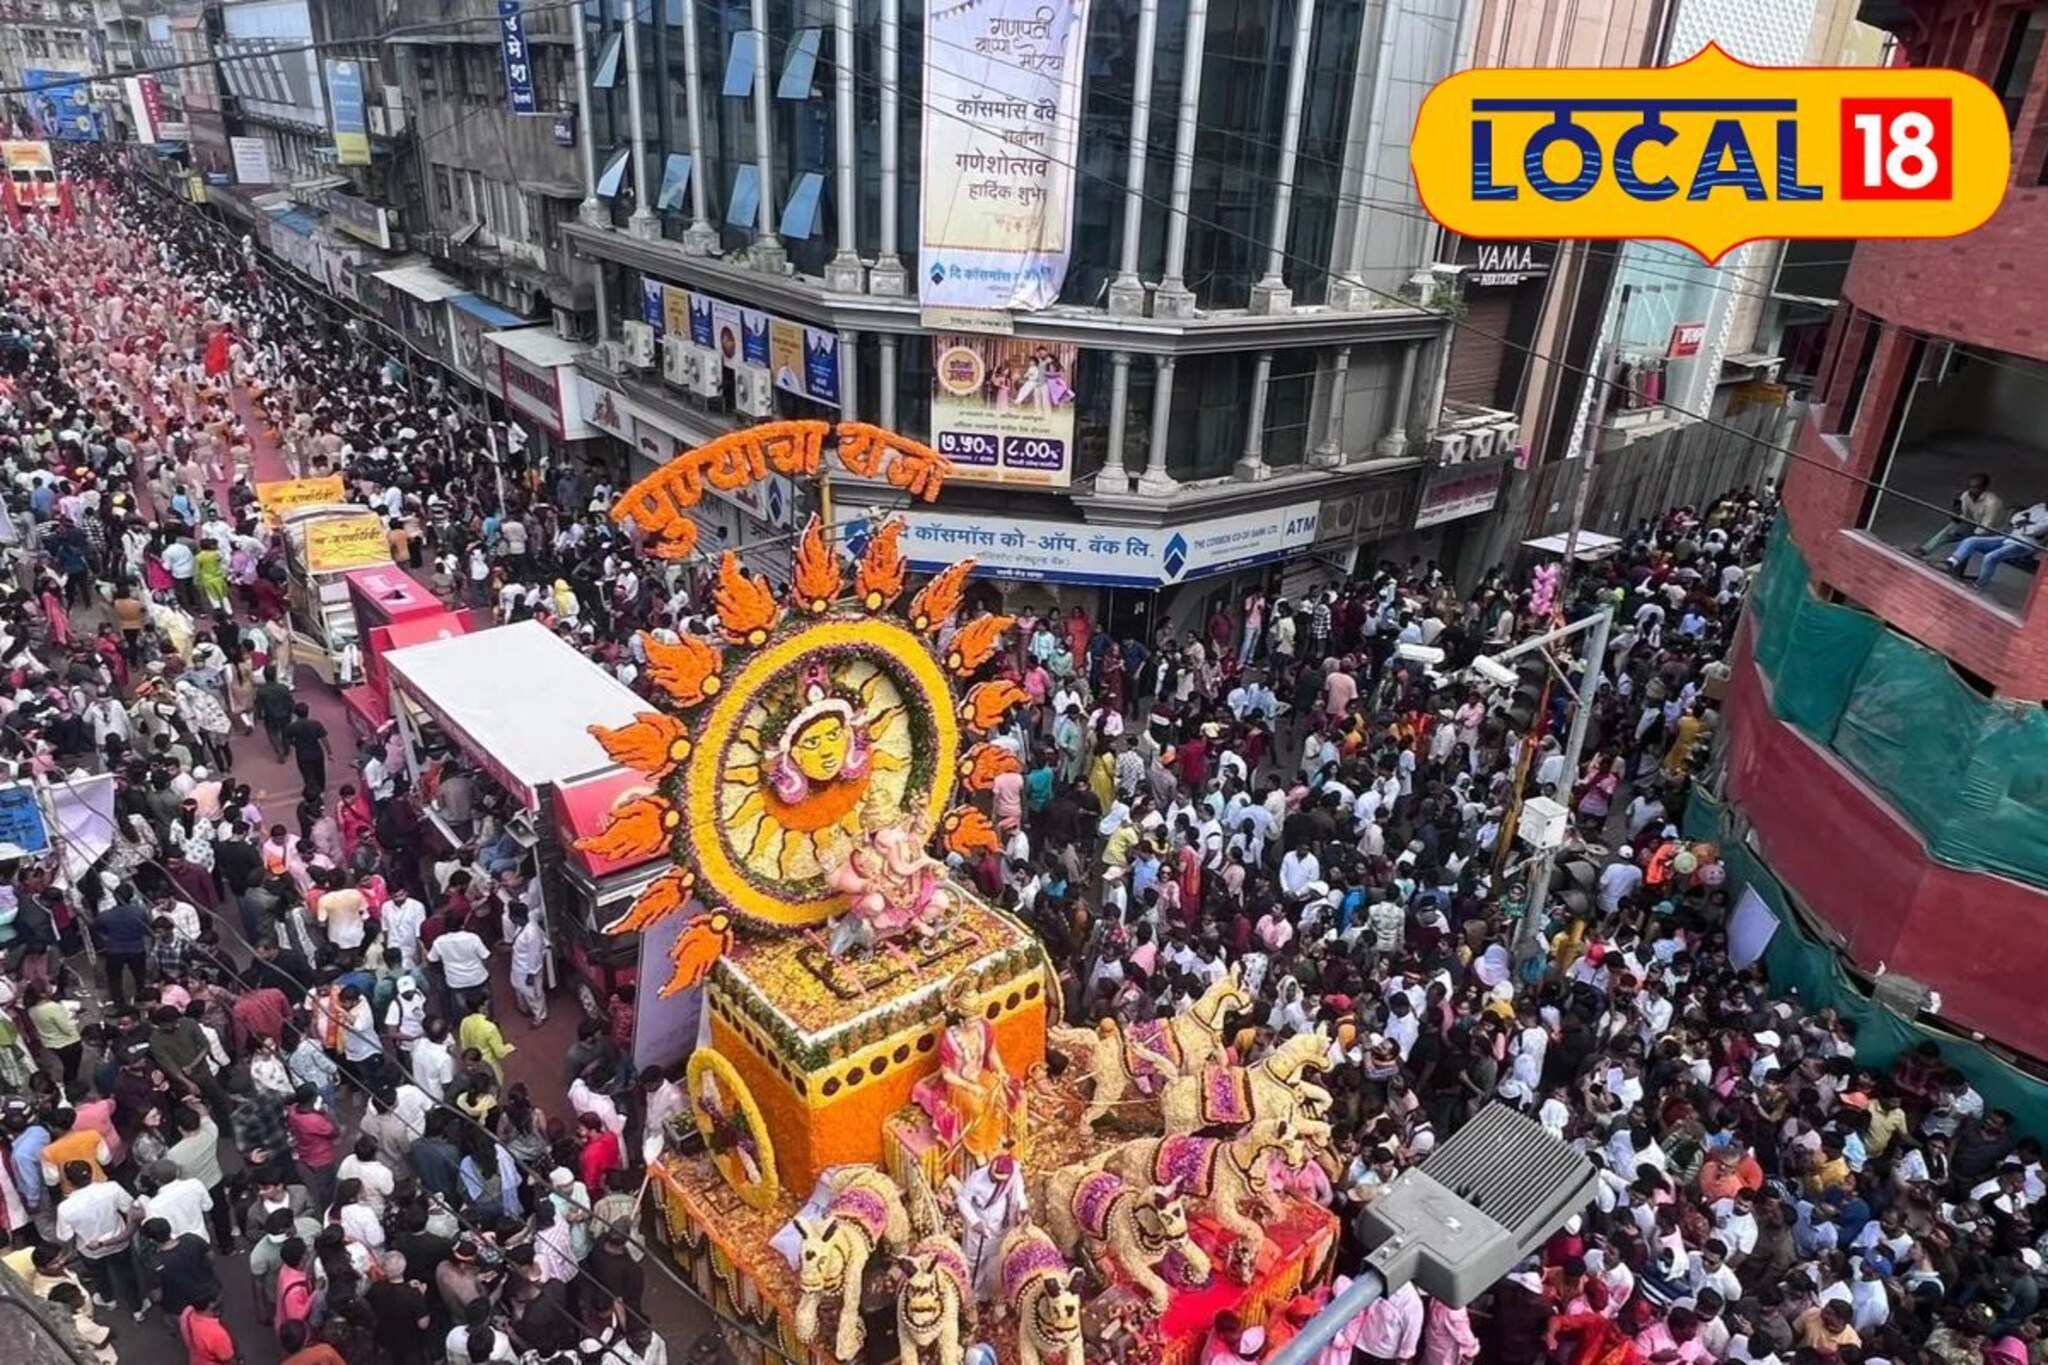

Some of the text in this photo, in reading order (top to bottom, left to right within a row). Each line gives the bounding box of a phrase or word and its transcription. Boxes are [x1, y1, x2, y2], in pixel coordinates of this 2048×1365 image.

[956, 94, 1027, 119] कॉसमॉस
[1478, 245, 1532, 270] VAMA
[610, 419, 956, 560] पुण्याचा राजा
[1286, 516, 1316, 536] ATM
[916, 522, 994, 546] कॉसमॉस
[1088, 538, 1120, 556] बँक
[1126, 536, 1156, 559] लि.
